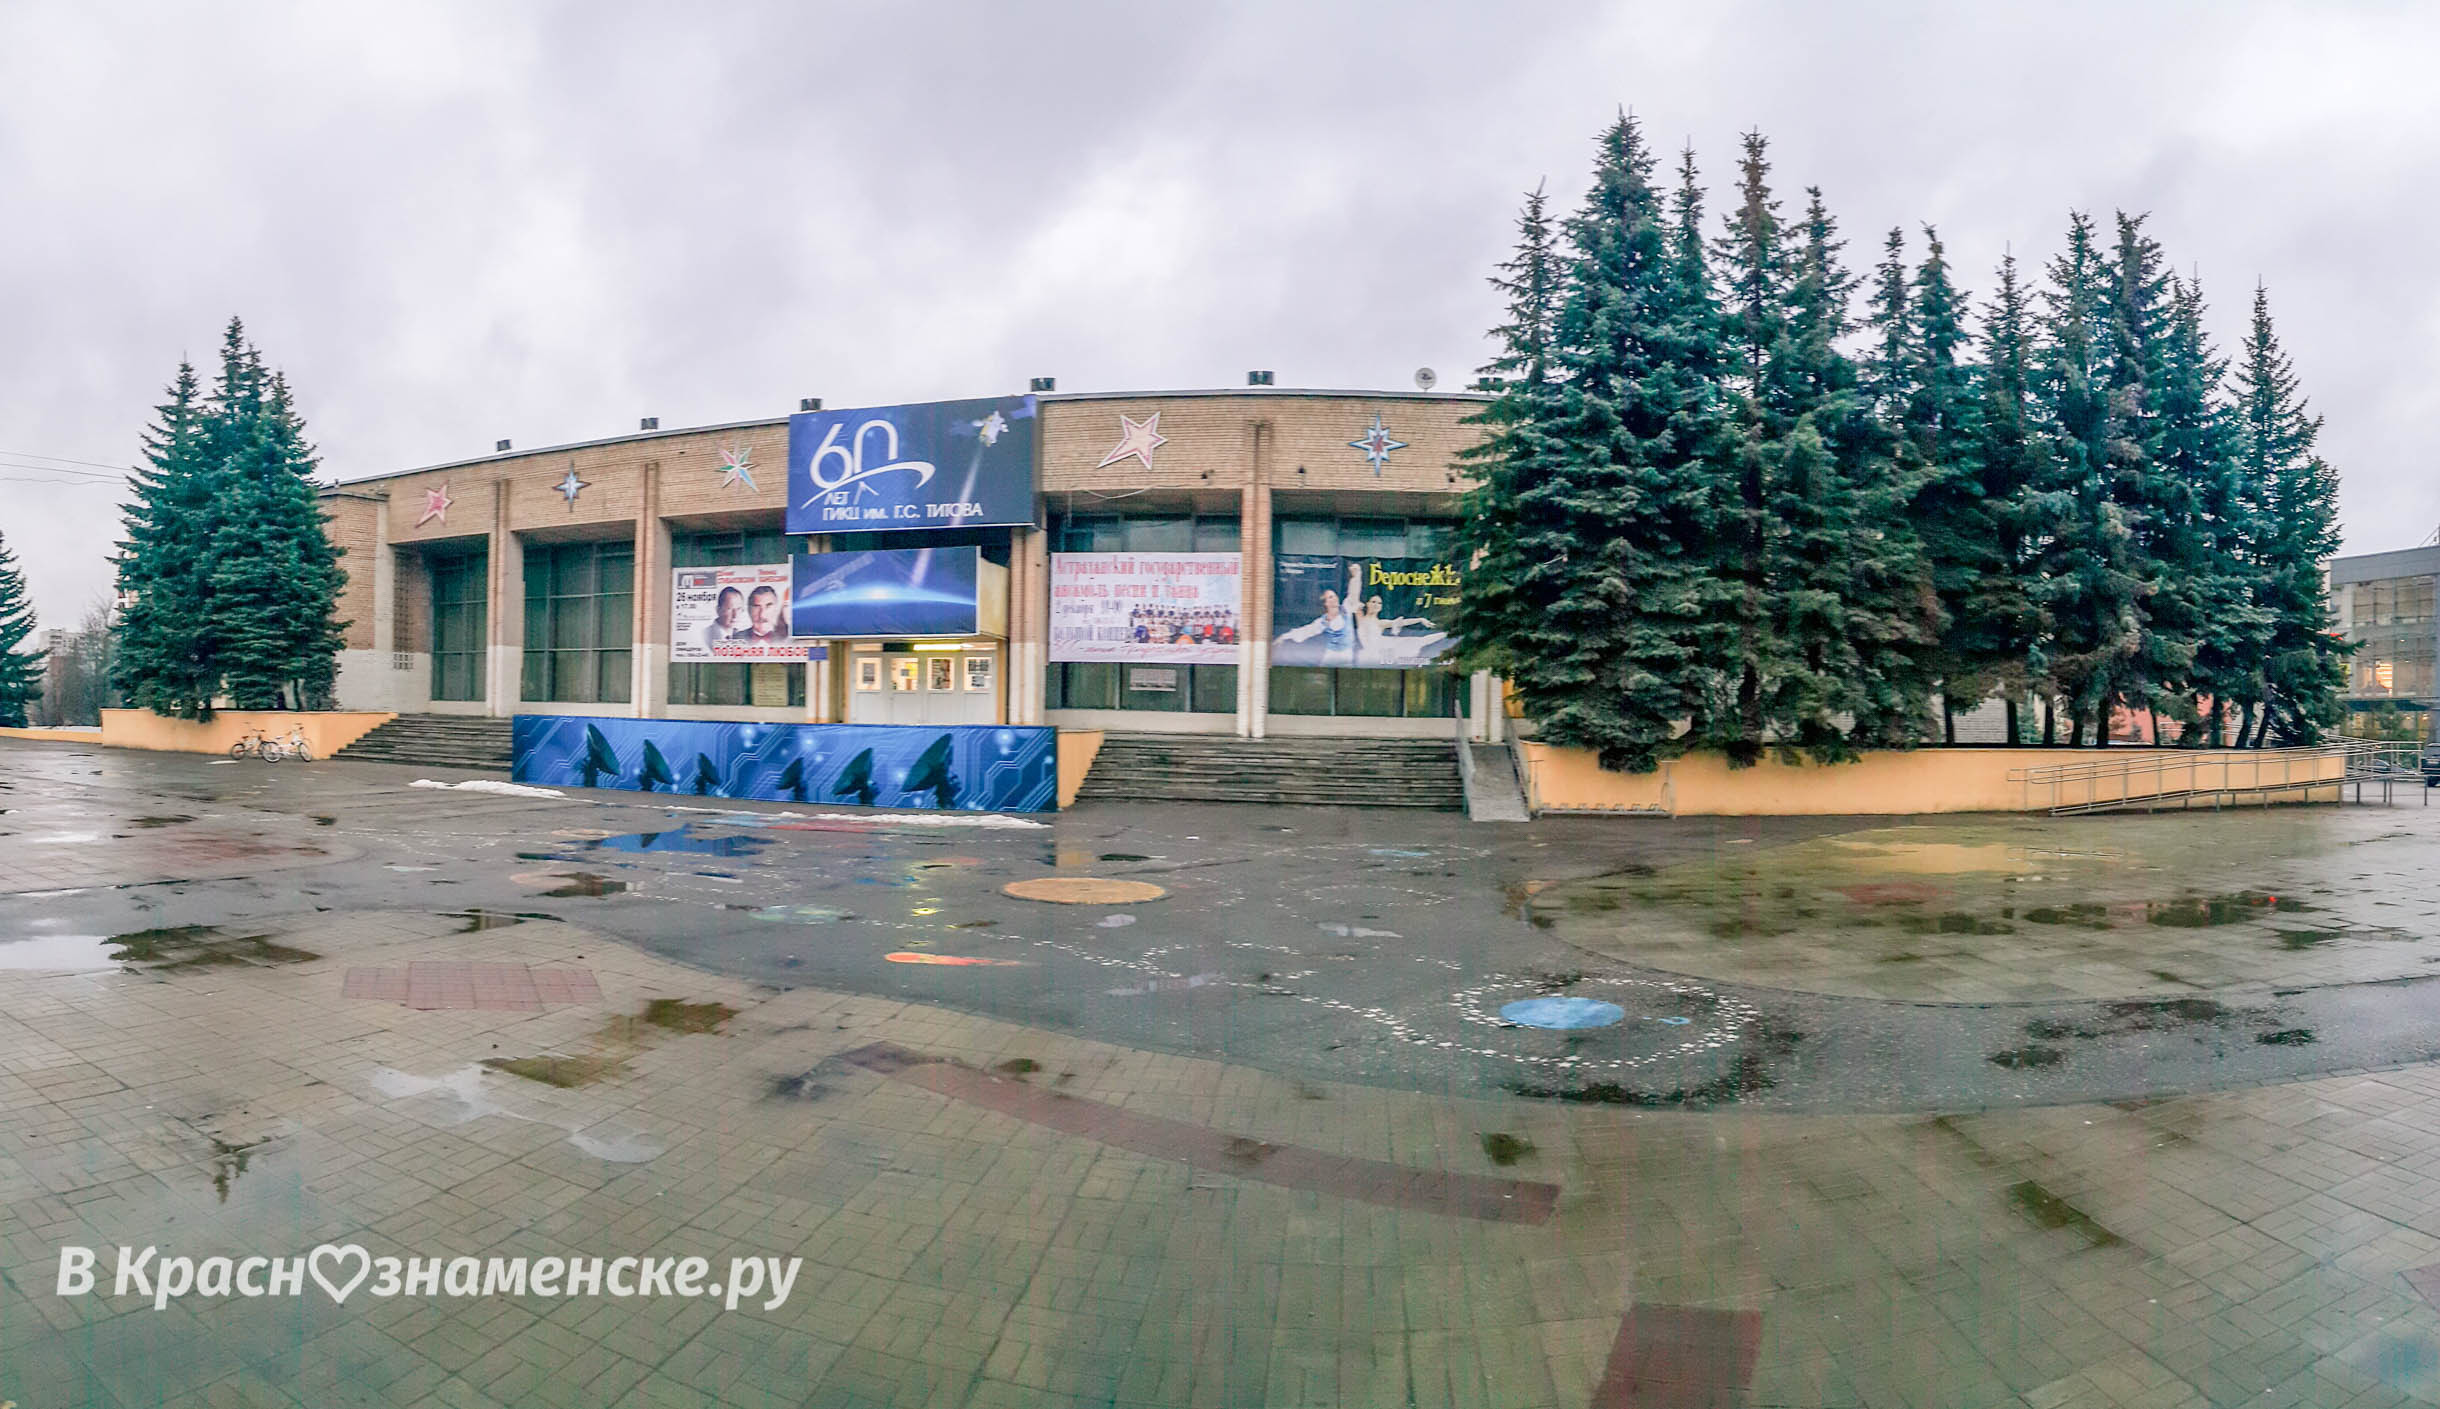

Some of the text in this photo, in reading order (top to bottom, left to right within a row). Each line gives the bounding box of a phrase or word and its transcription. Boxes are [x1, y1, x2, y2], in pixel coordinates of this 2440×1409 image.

[810, 420, 899, 489] 60
[824, 491, 850, 505] ЛЕТ
[822, 507, 860, 521] ГИКЦ
[893, 505, 921, 519] Г.С.
[925, 502, 984, 518] ТИТОВА
[768, 647, 809, 657] ЛЮБОВ
